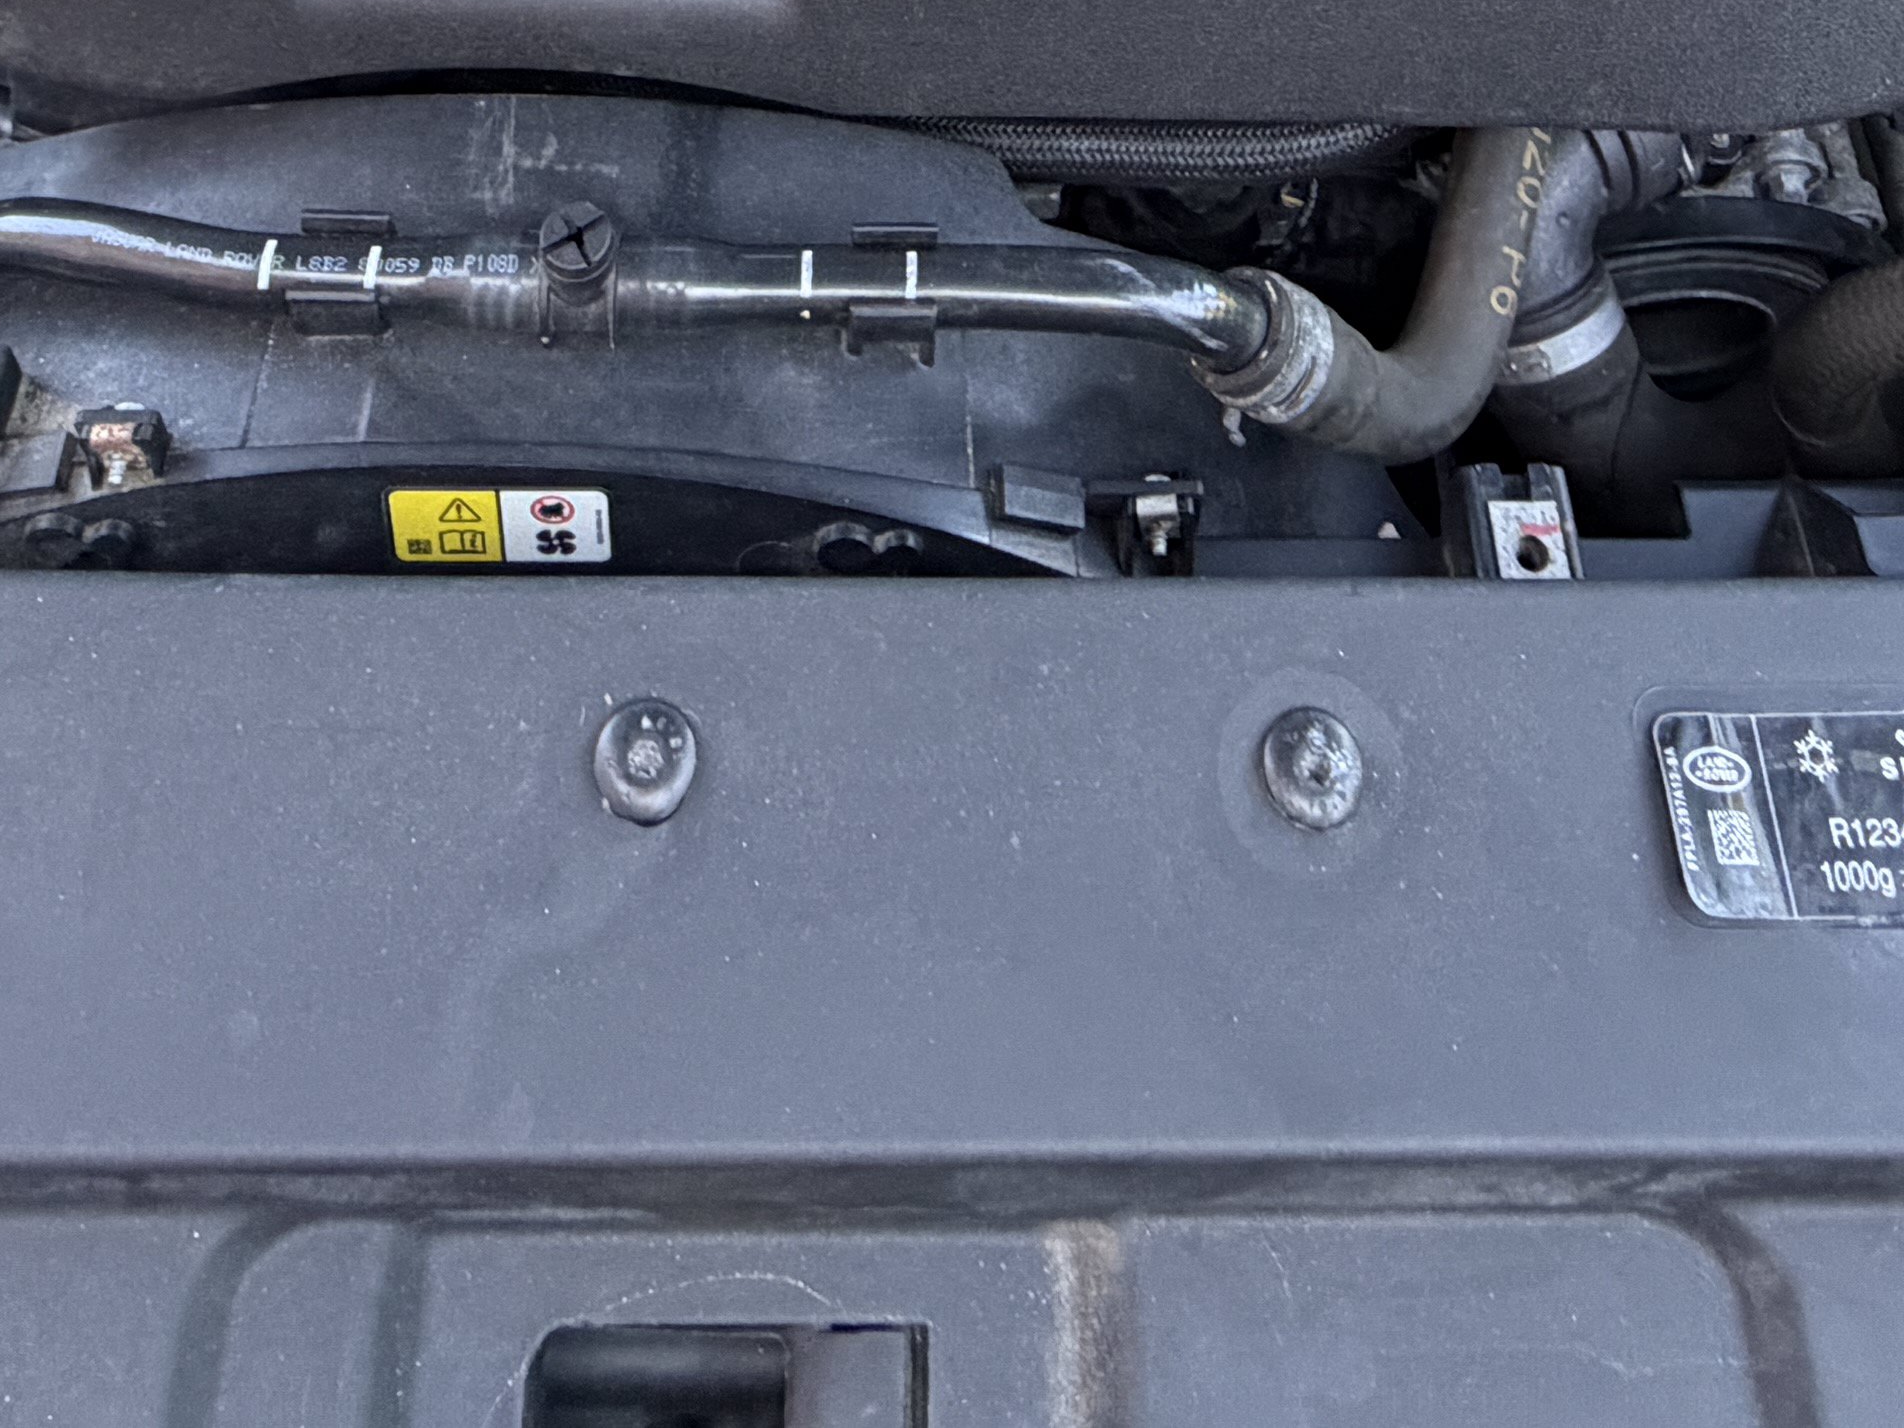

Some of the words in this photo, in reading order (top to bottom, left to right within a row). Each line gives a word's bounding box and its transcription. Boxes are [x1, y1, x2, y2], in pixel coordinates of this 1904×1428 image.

[222, 249, 286, 270] ROVR
[358, 255, 421, 274] 8059
[1820, 860, 1896, 898] 1000g
